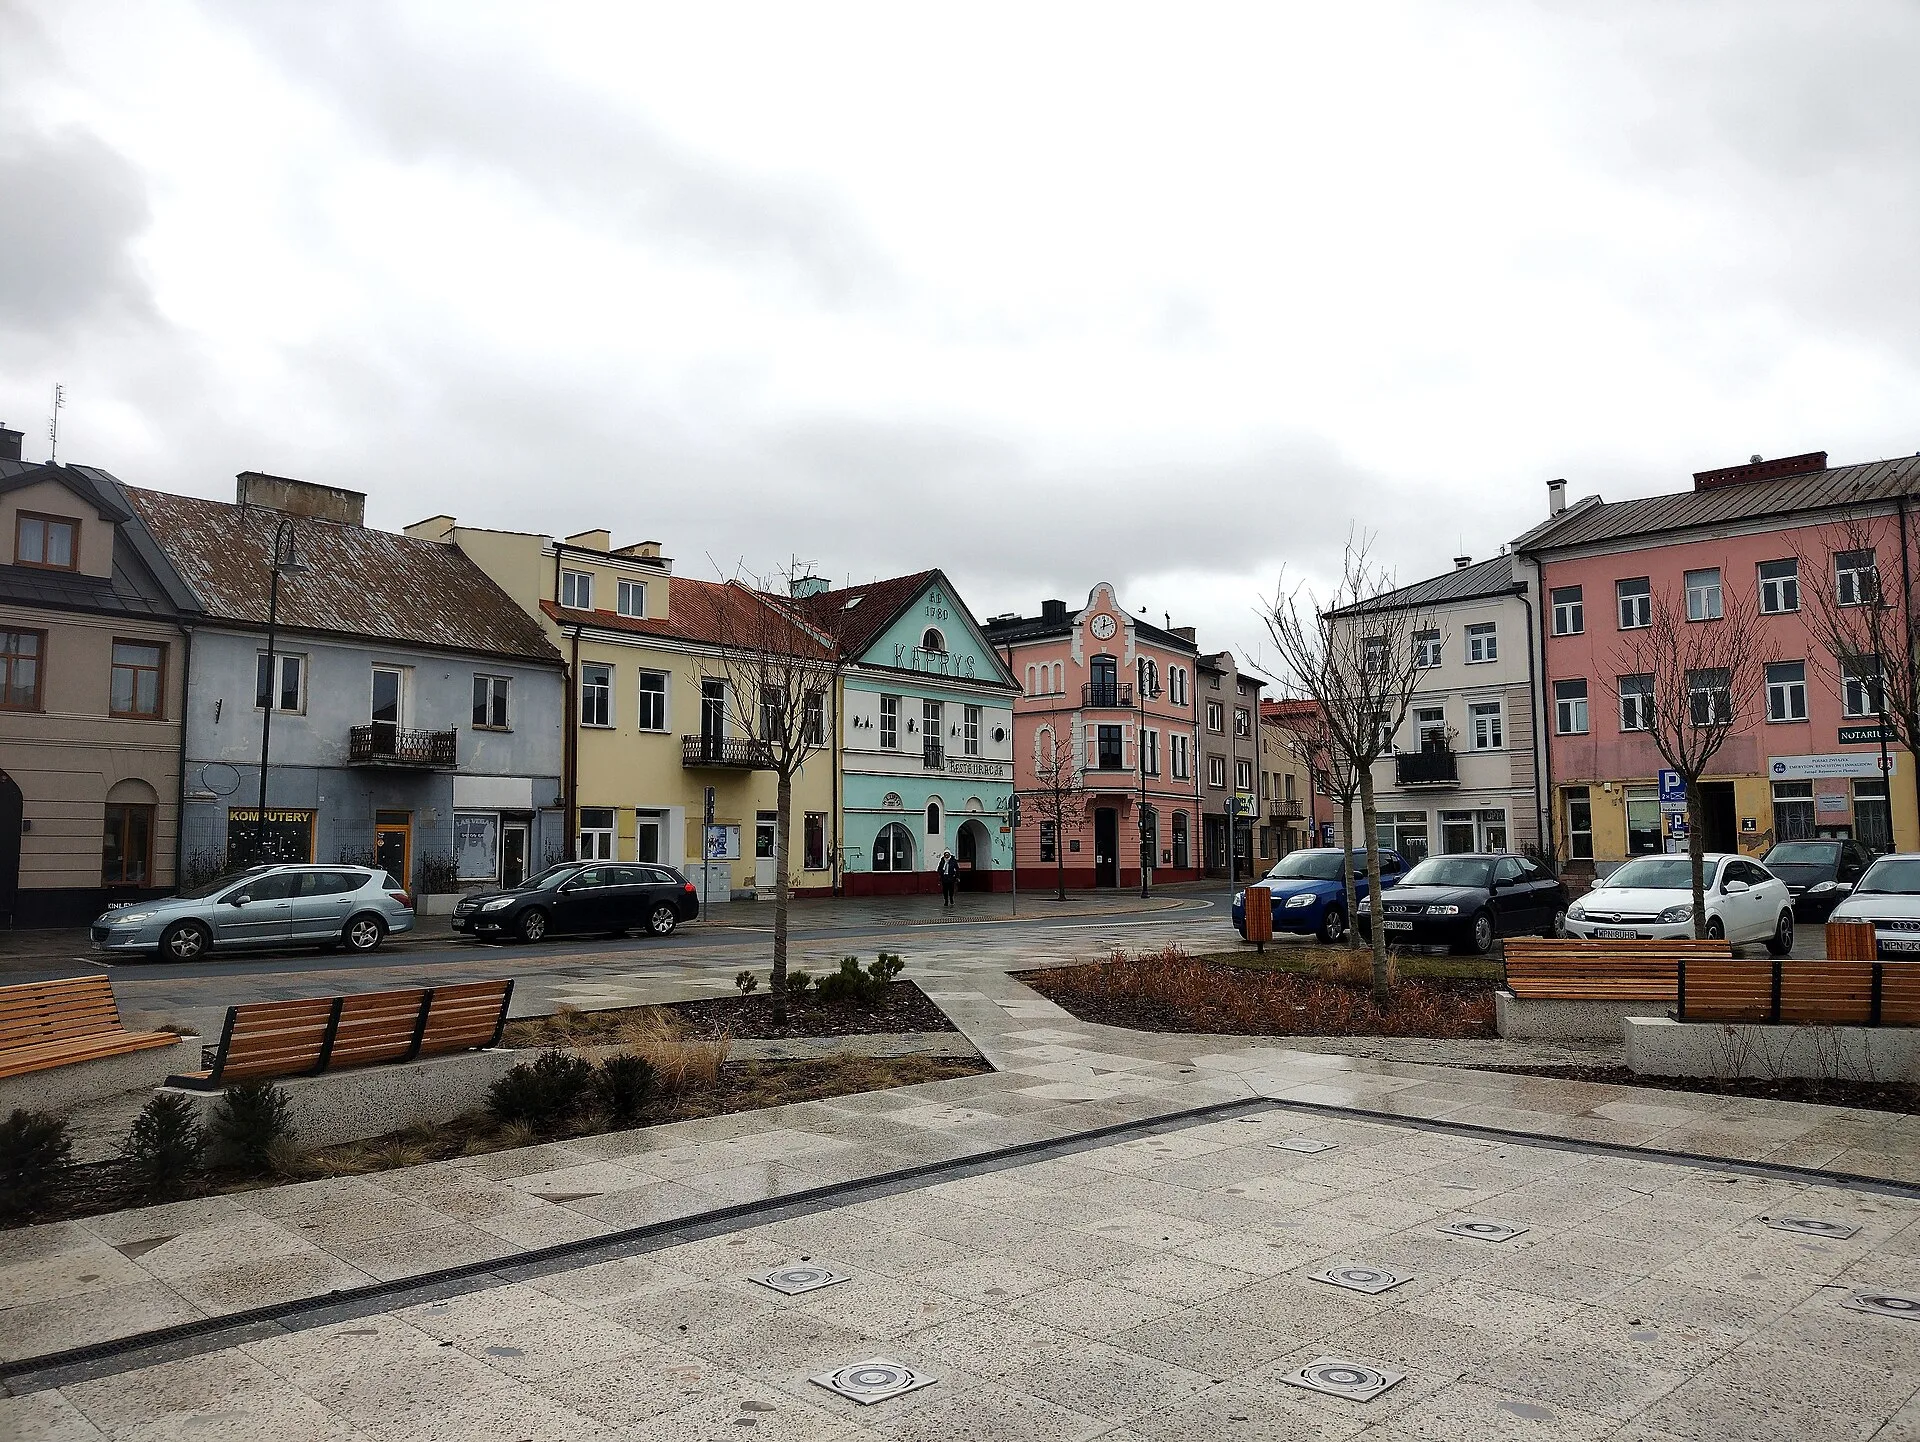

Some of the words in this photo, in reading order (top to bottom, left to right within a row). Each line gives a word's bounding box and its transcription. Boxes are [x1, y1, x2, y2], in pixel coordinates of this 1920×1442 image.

[894, 642, 975, 679] KAPRYS
[1664, 772, 1681, 793] P
[1674, 814, 1682, 829] P
[1327, 827, 1334, 837] P
[1883, 941, 1903, 950] WPN
